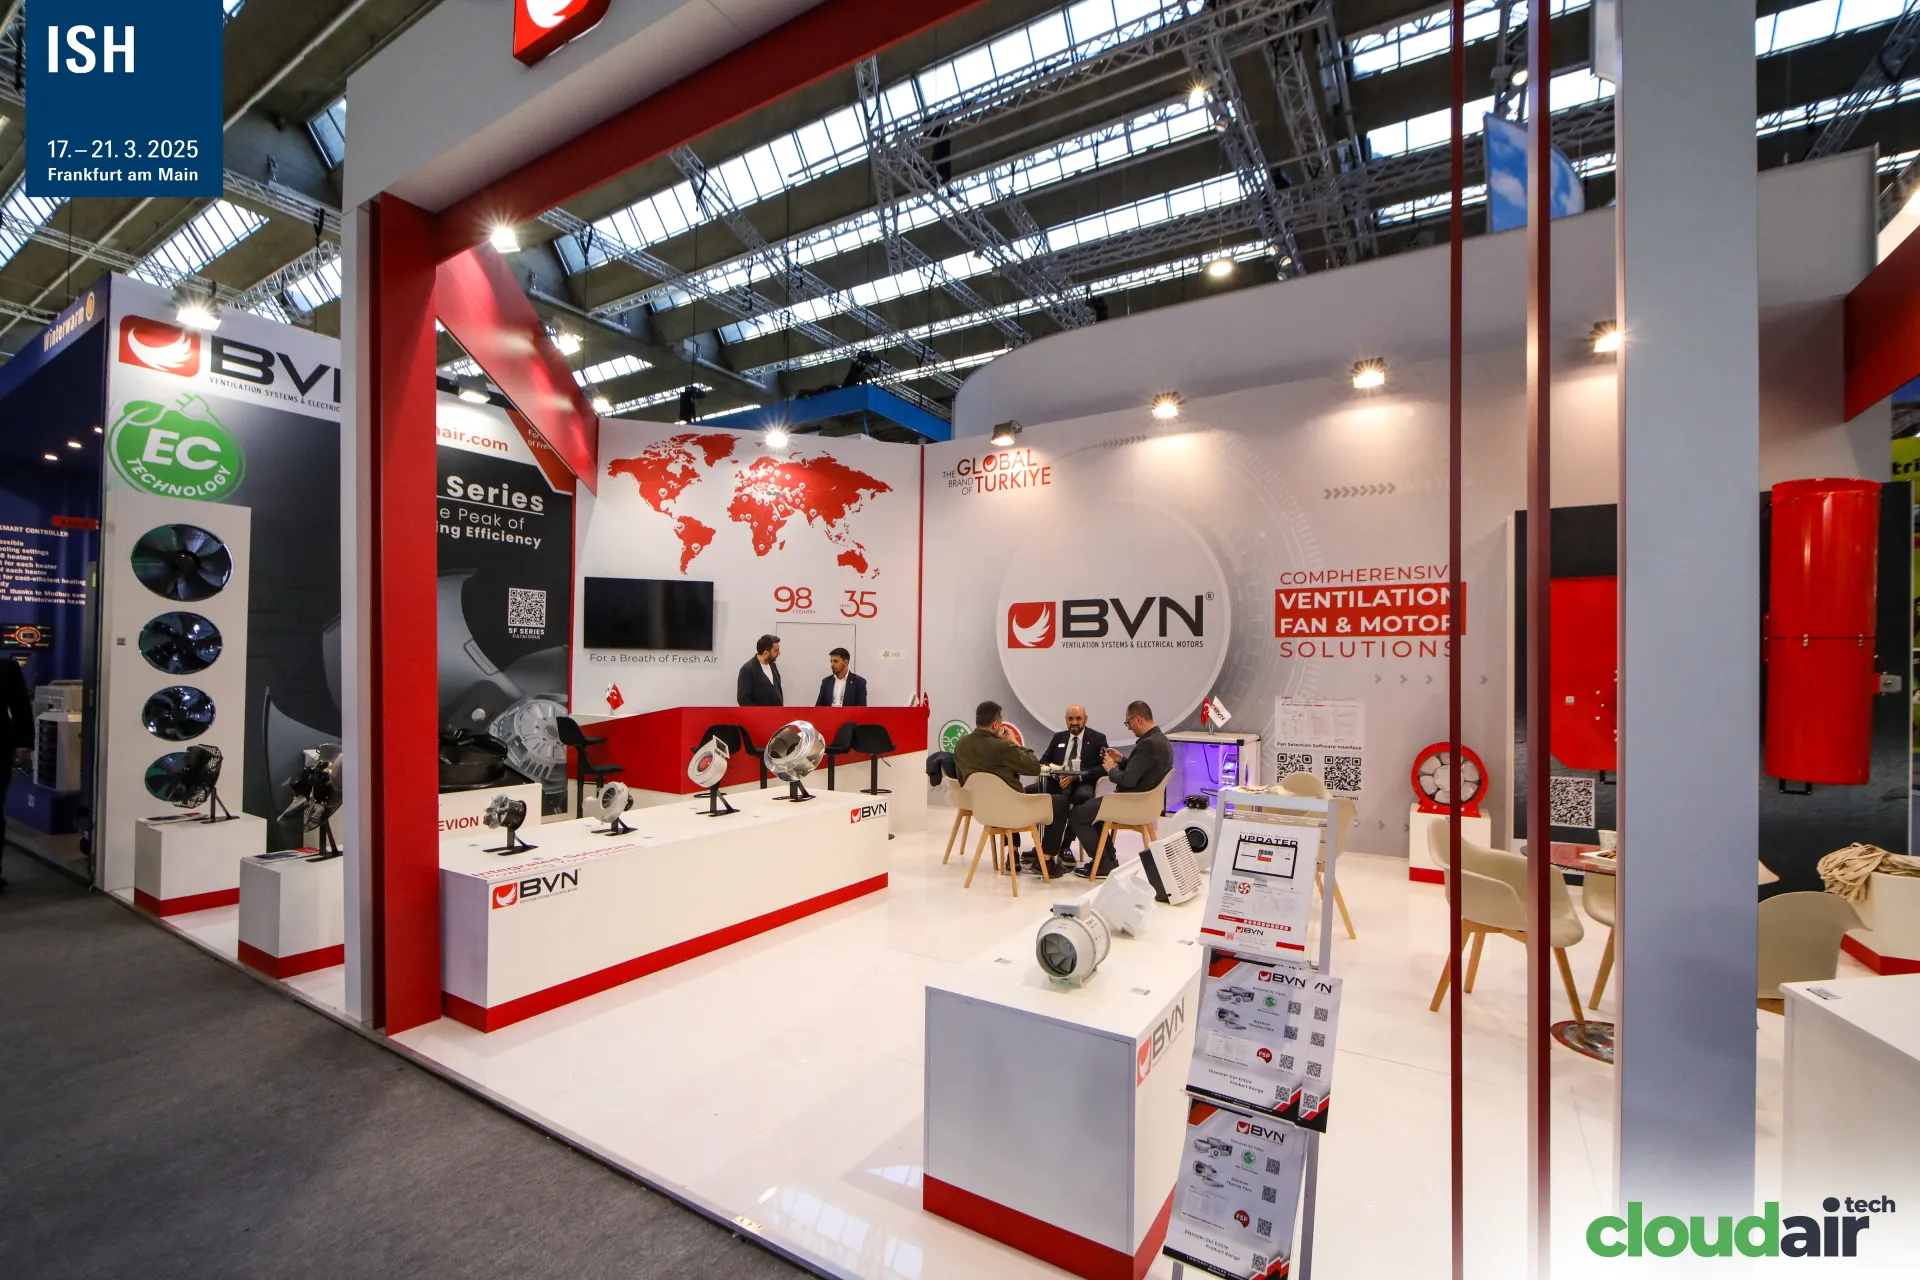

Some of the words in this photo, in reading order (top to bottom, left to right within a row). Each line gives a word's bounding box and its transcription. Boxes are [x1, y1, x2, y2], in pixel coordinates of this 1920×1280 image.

[44, 306, 84, 352] Winterwarm
[210, 335, 341, 403] BV
[209, 376, 262, 394] VENTILATION
[265, 389, 298, 402] SYSTEMS
[142, 428, 221, 470] EC
[957, 449, 1037, 476] GLOBAL
[127, 457, 231, 497] TECHNOLOGY
[942, 470, 956, 479] THE
[948, 478, 973, 488] BRAND
[975, 466, 1051, 493] TURKIYE
[446, 475, 544, 512] Series
[961, 487, 972, 495] OF
[459, 508, 501, 527] Peak
[508, 518, 525, 530] of
[25, 527, 69, 537] CONTROLLER
[466, 526, 542, 549] Efficiency
[7, 553, 34, 561] heaters
[22, 548, 49, 556] settings
[25, 568, 47, 576] heater
[36, 562, 57, 570] heater
[1280, 564, 1449, 585] COMPHERENSIV
[61, 578, 86, 587] heating
[25, 596, 65, 604] Winterwarm
[774, 586, 813, 613] 98
[840, 590, 878, 619] 35
[1062, 594, 1204, 641] BVN
[1281, 617, 1327, 634] FAN
[1335, 616, 1351, 633] &
[1062, 641, 1099, 649] VENTILATION
[589, 653, 607, 662] For
[619, 653, 656, 663] Breath
[658, 654, 669, 663] of
[672, 654, 701, 663] Fresh
[703, 655, 718, 663] Air
[861, 802, 887, 819] BVN
[1239, 834, 1299, 847] UPDATED
[519, 868, 578, 899] BVN
[1243, 927, 1264, 936] BVN
[1272, 972, 1306, 988] BVN
[1152, 996, 1185, 1061] BVN
[1258, 1051, 1271, 1059] FSP
[1250, 1124, 1285, 1144] BVN
